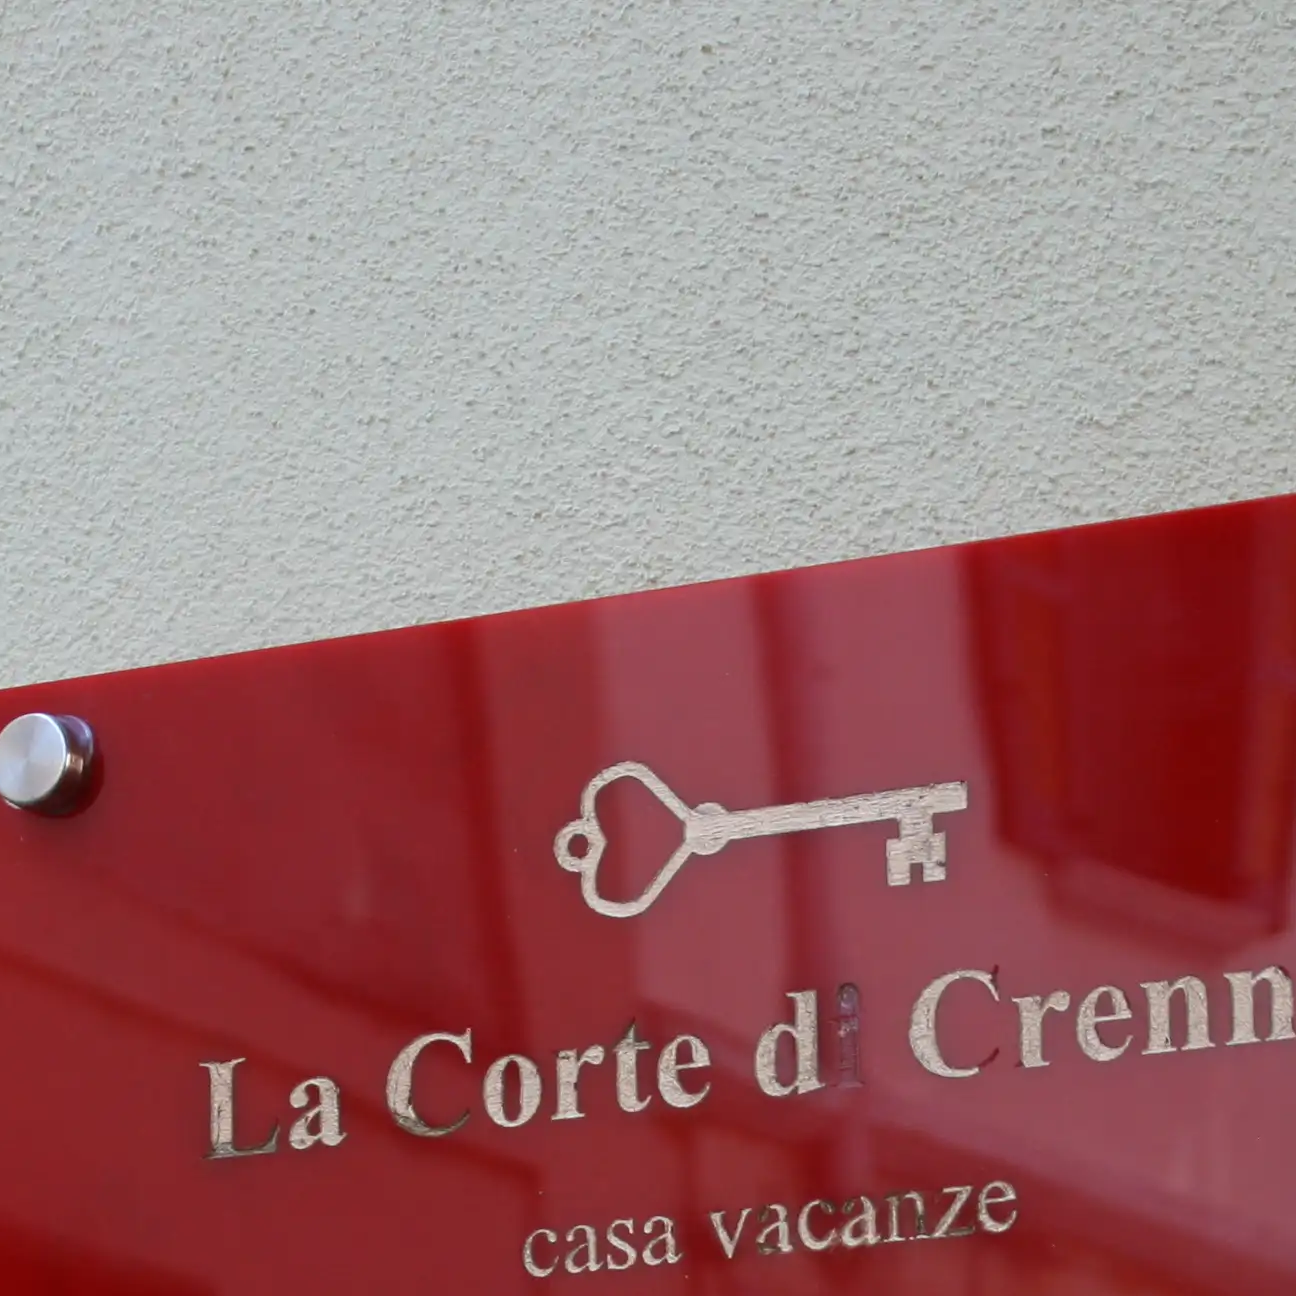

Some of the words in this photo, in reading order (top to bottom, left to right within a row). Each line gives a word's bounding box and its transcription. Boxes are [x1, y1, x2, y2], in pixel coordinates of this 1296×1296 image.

[199, 1057, 347, 1160] La
[385, 1017, 712, 1137] Corte
[754, 981, 865, 1098] di
[522, 1212, 683, 1278] casa
[709, 1178, 1019, 1260] vacanze
